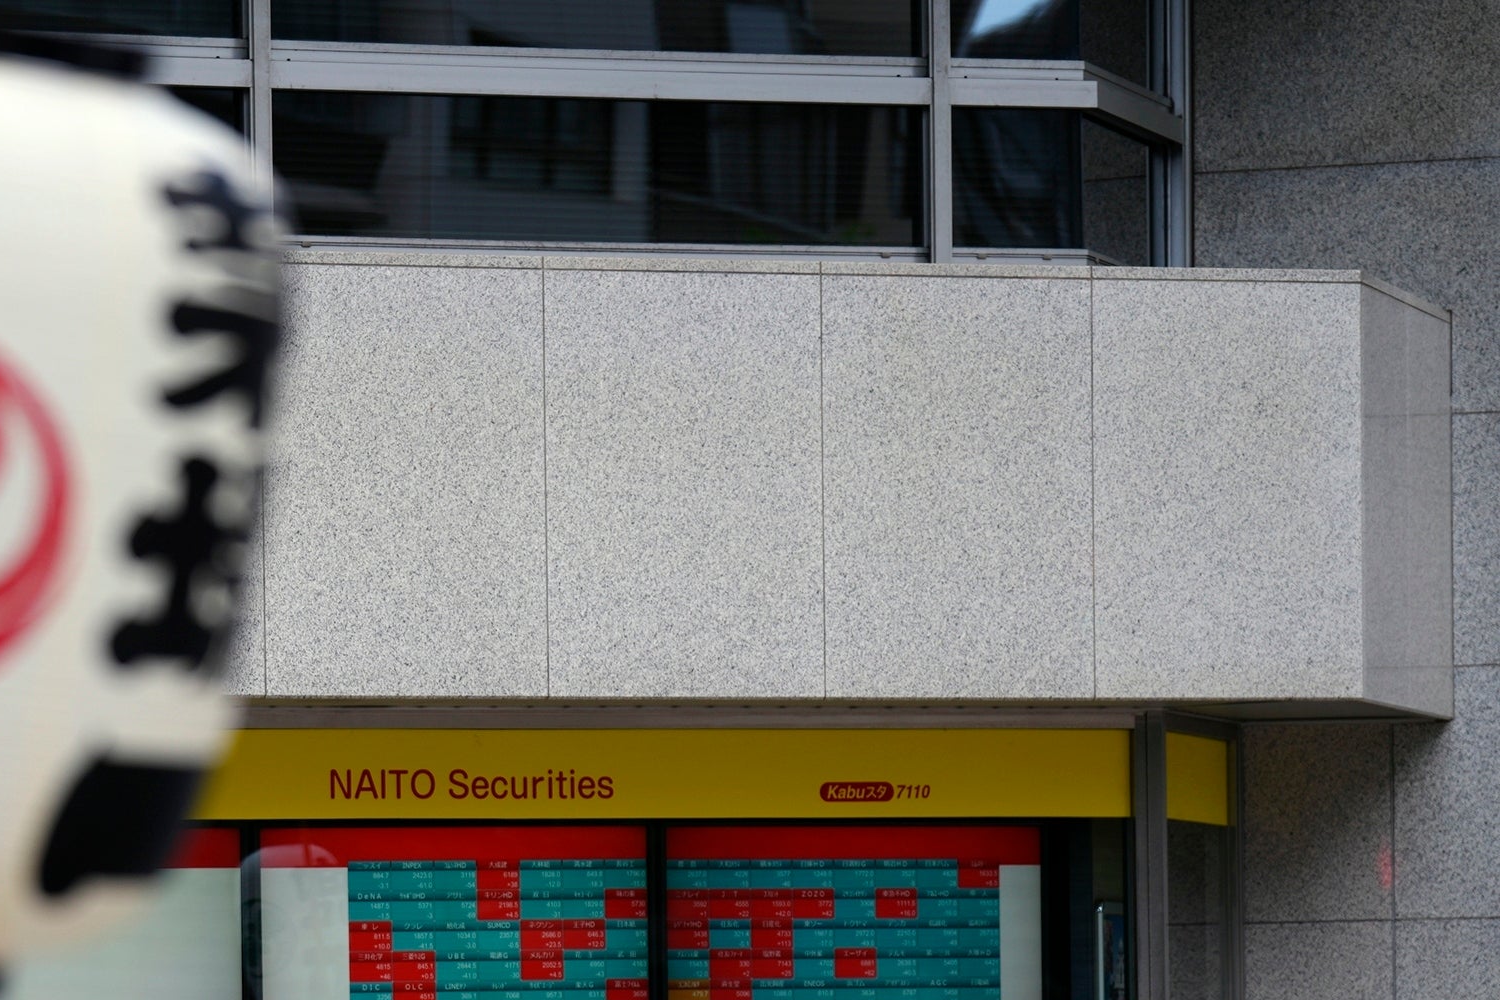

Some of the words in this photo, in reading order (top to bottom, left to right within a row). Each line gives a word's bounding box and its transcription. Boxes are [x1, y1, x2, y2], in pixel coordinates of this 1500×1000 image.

[330, 769, 436, 800] NAITO
[448, 768, 615, 800] Securities
[826, 783, 887, 800] Kabuスタ
[895, 784, 931, 799] 7110
